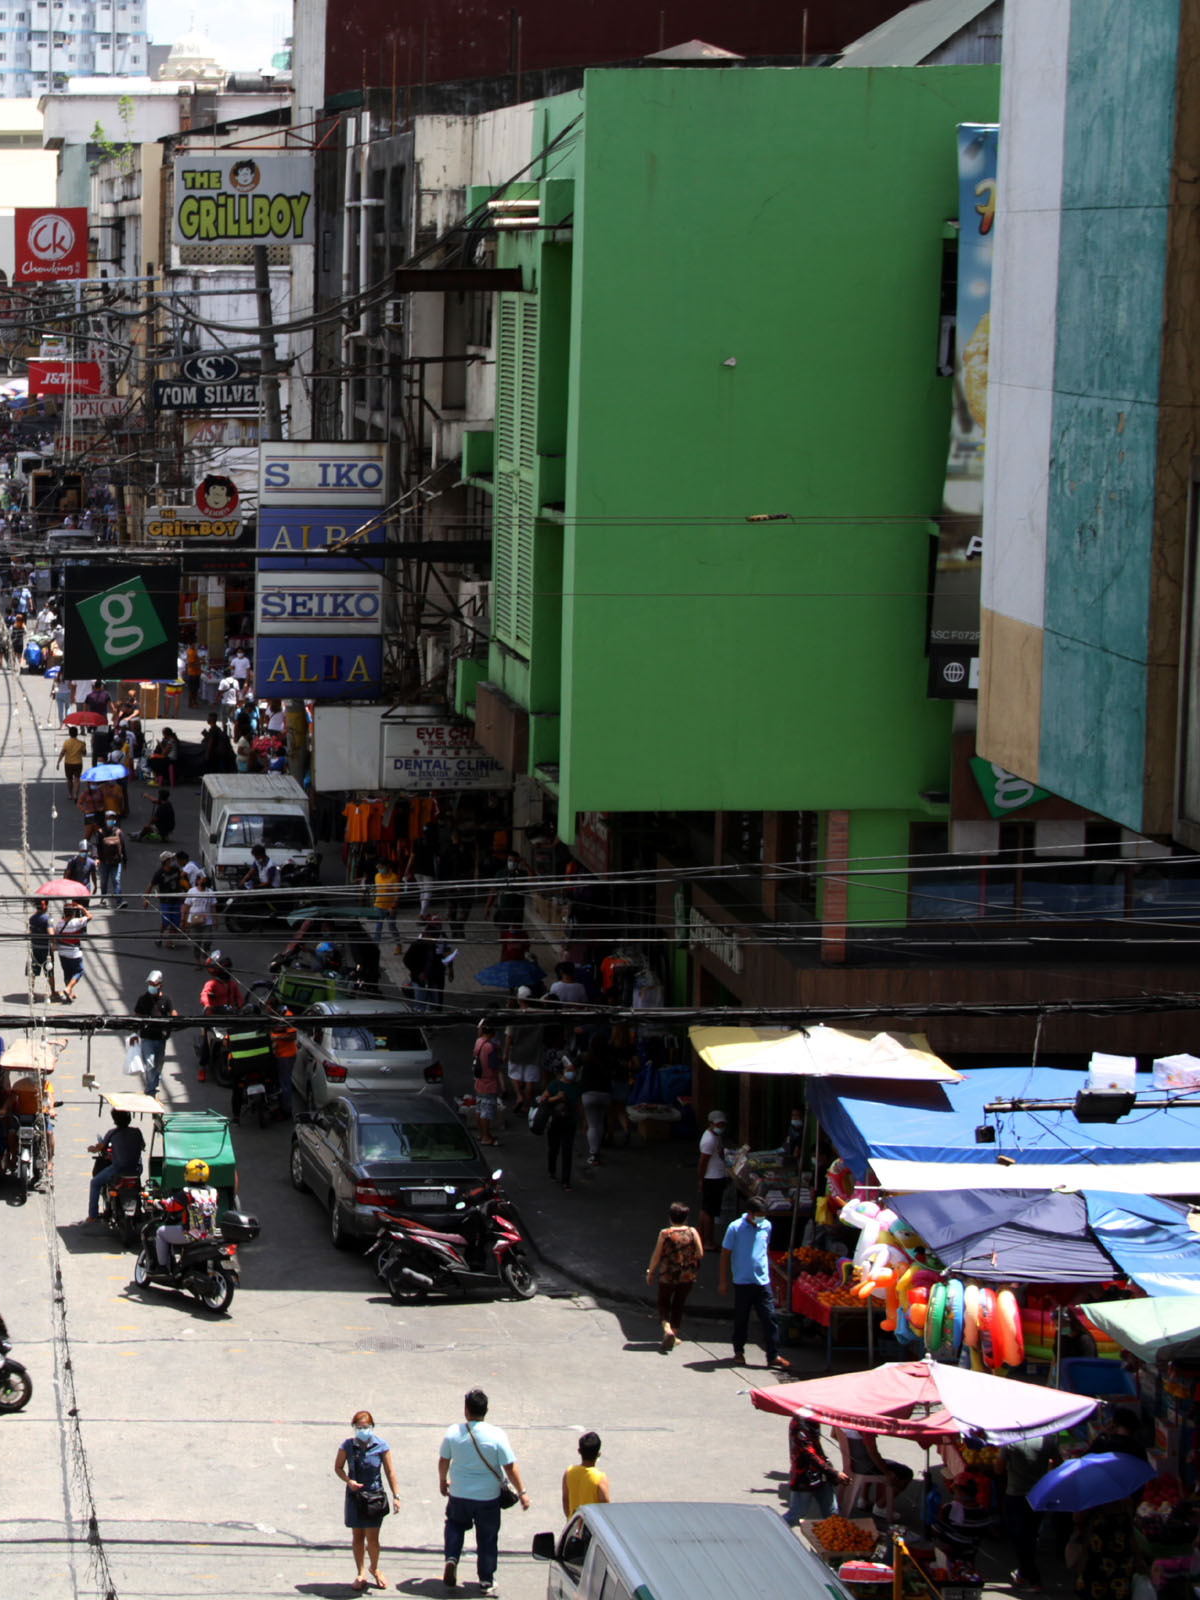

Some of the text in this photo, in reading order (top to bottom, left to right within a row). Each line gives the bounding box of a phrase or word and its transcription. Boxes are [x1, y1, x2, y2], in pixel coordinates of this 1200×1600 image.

[182, 170, 222, 190] THE
[33, 223, 69, 251] Ck
[21, 261, 73, 275] Chowking
[41, 373, 68, 385] J&T
[159, 386, 197, 405] TOM
[160, 508, 176, 519] THE
[261, 592, 379, 617] SEIKO
[100, 590, 144, 656] g
[416, 727, 445, 739] EYE
[393, 759, 450, 770] DENTAL
